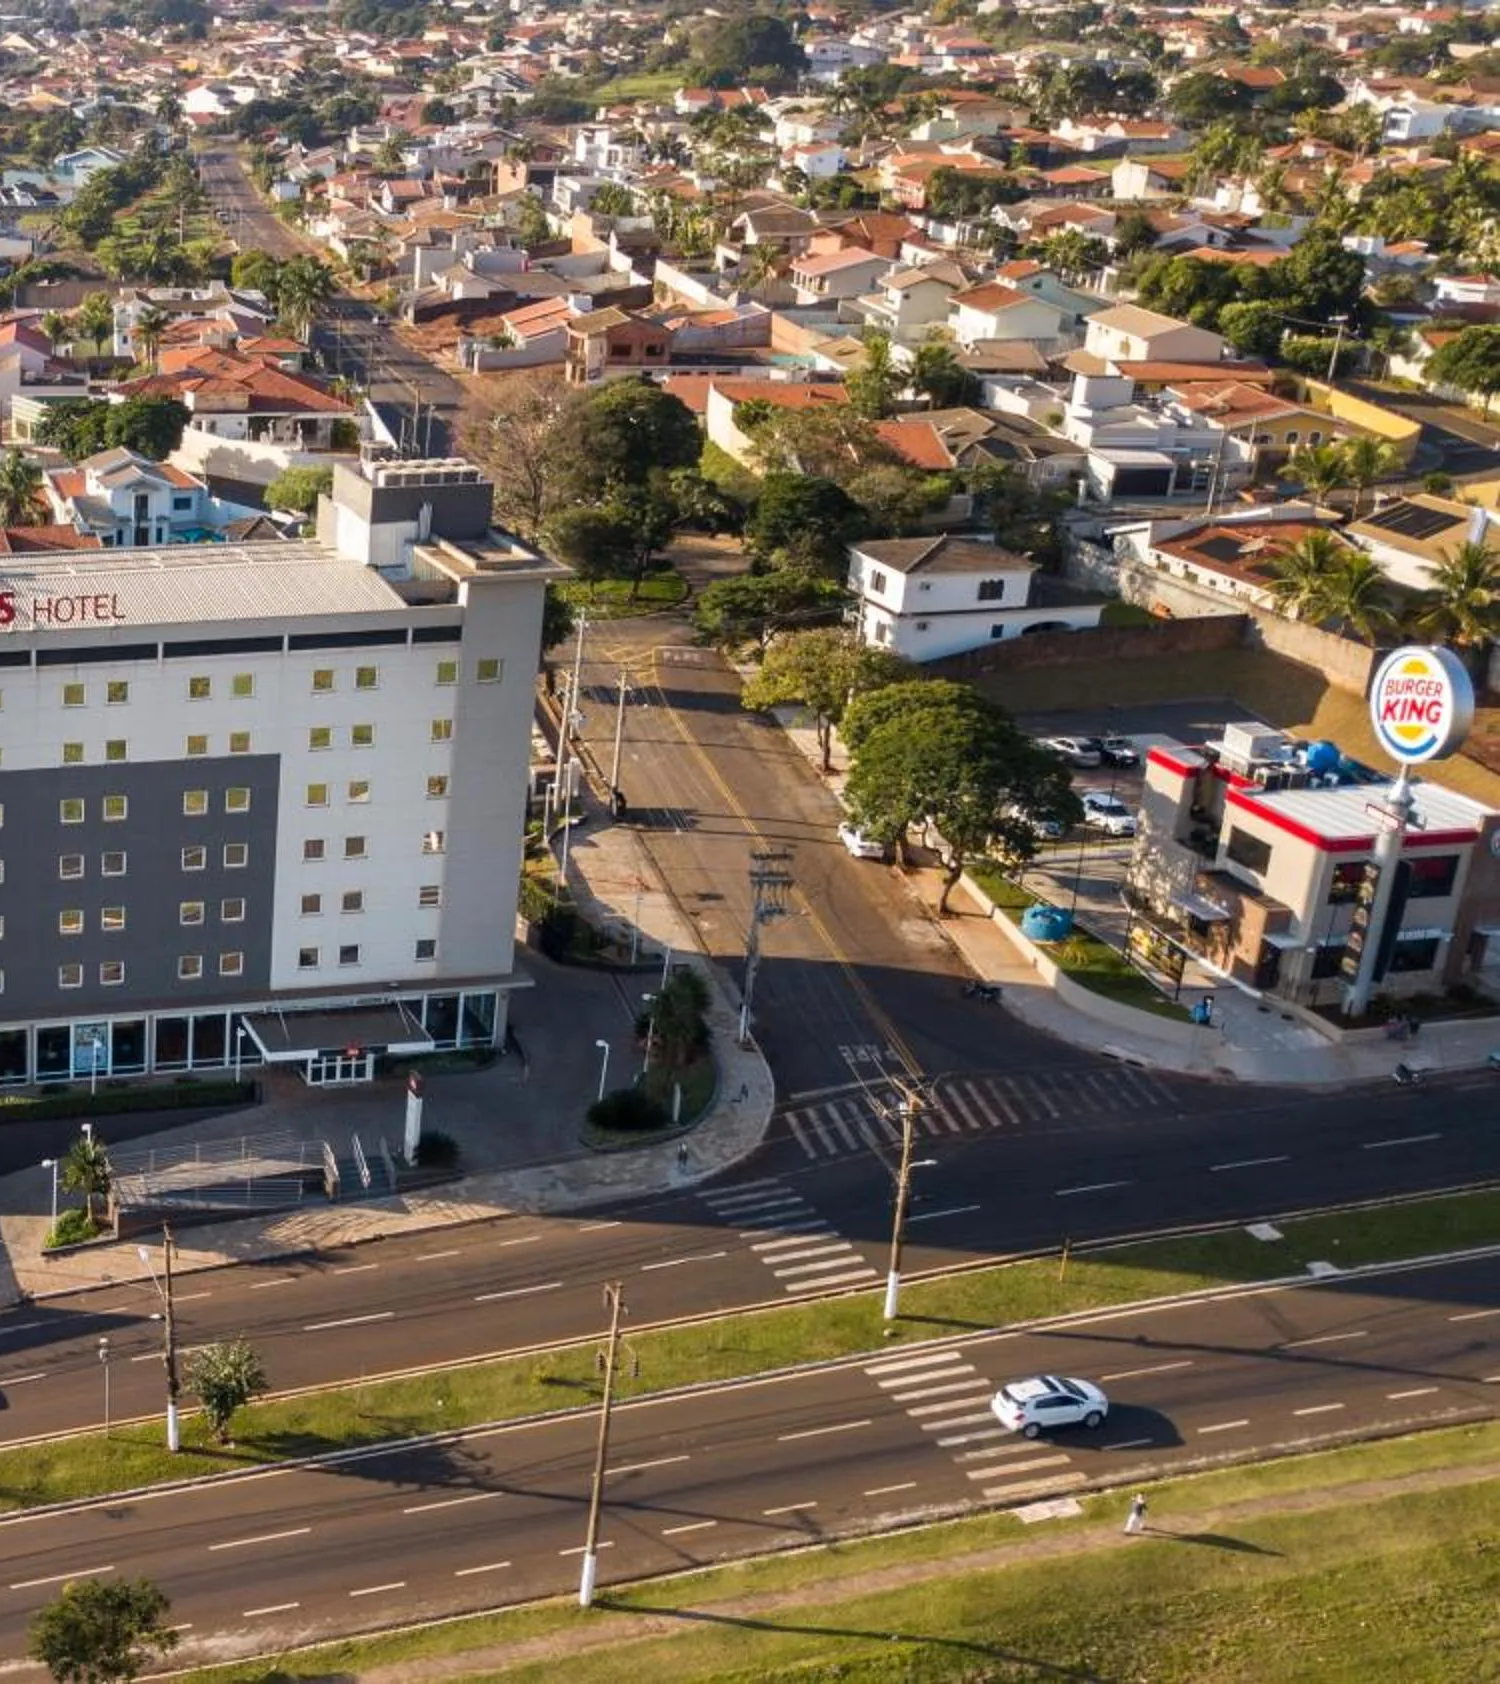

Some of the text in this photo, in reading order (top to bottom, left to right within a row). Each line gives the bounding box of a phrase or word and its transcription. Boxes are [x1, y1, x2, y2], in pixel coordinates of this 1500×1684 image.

[33, 593, 126, 623] HOTEL
[1384, 678, 1443, 697] BURGER
[1381, 697, 1444, 724] KING
